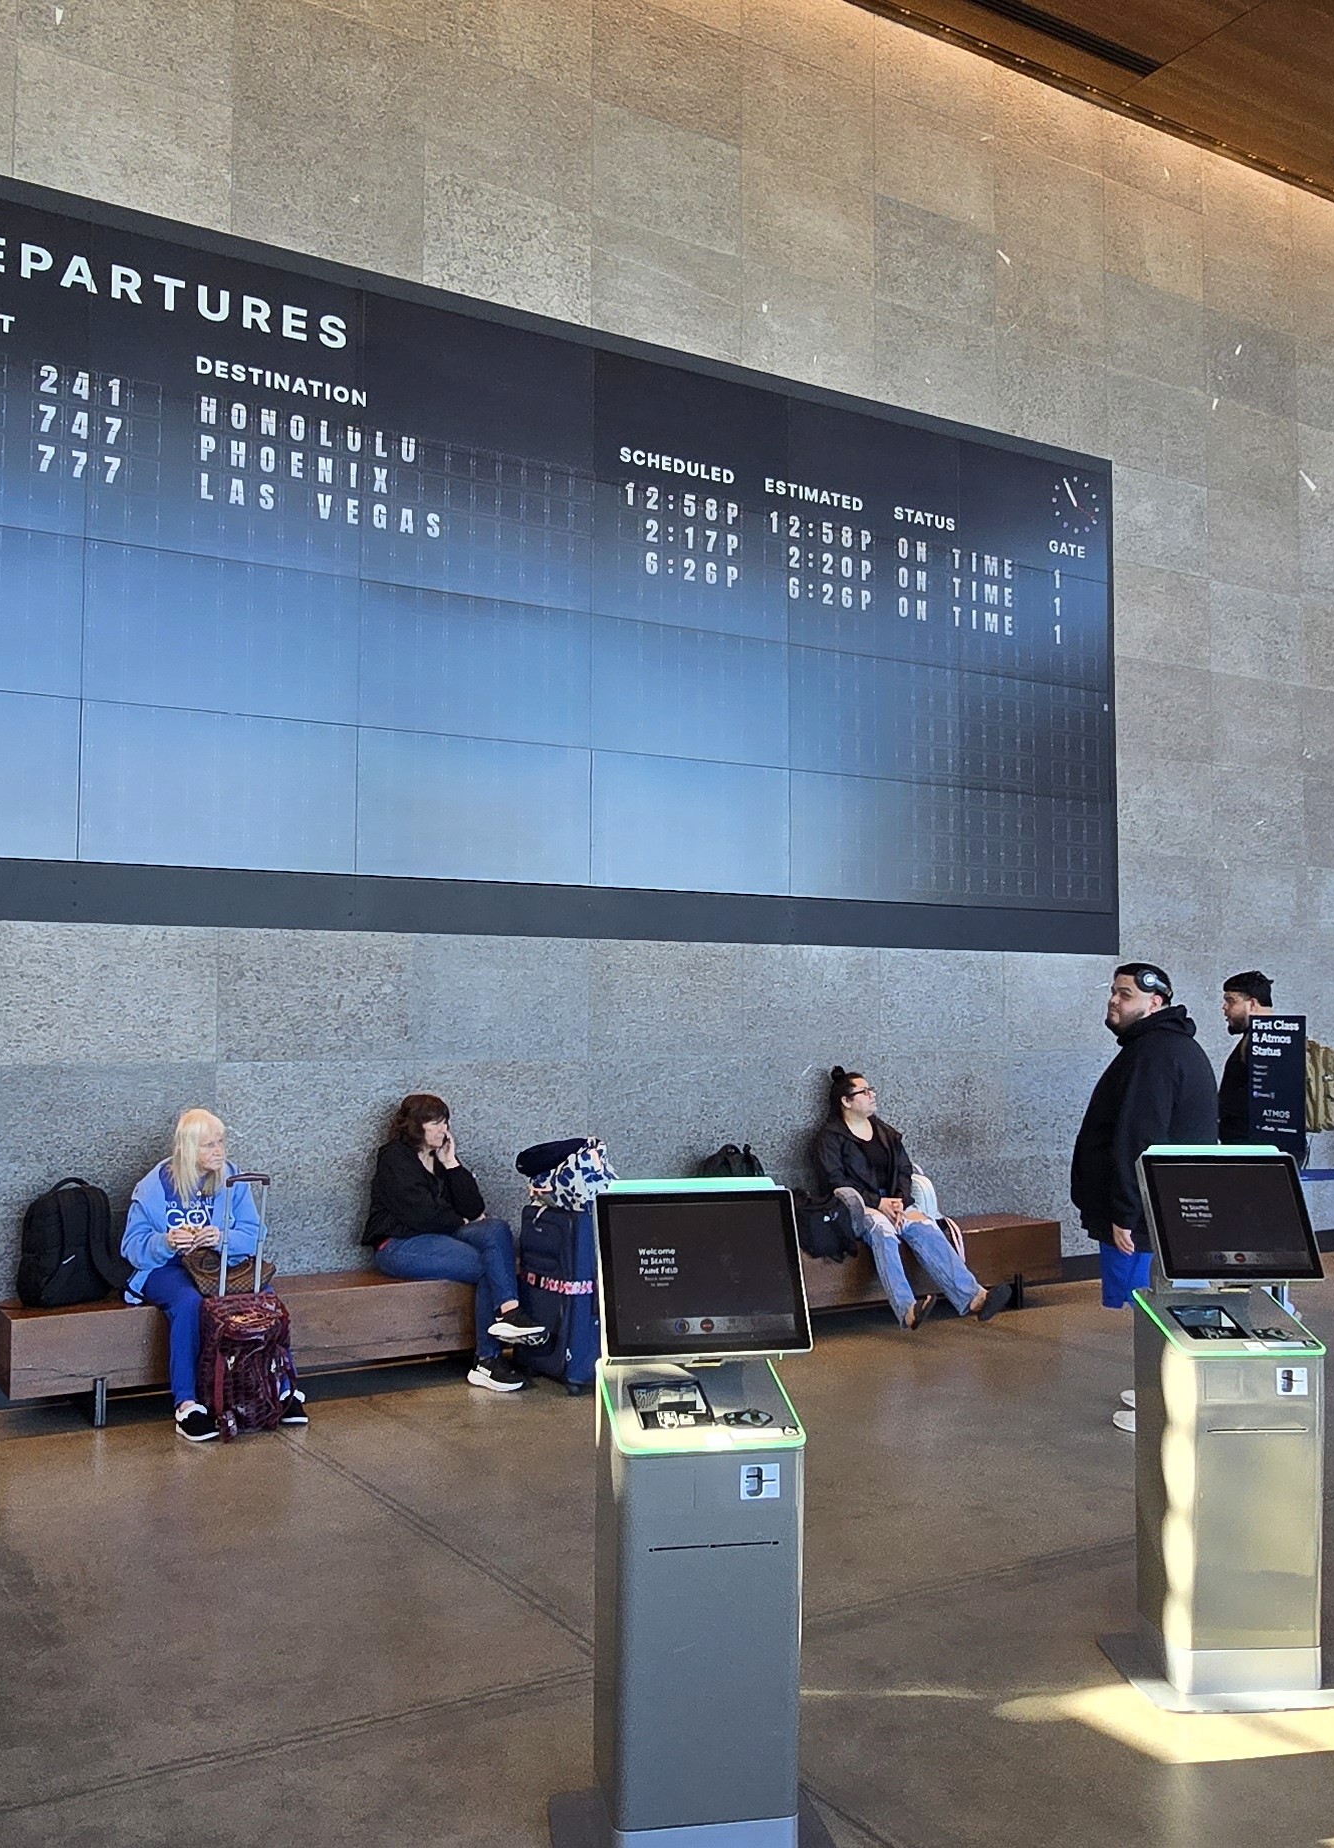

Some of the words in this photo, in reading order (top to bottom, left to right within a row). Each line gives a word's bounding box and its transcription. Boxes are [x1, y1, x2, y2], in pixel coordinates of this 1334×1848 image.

[38, 404, 122, 444] 747
[200, 434, 388, 493] PHOENIX
[645, 519, 739, 556] 2:17P
[788, 546, 872, 581] 2:20P
[898, 567, 927, 592] ON
[952, 577, 1013, 608] TIME
[1054, 597, 1061, 616] 1
[39, 365, 121, 406] 241
[200, 396, 416, 462] HONOLULU
[625, 482, 739, 525] 12:58P
[770, 511, 872, 551] 12:58P
[898, 537, 927, 563] ON
[952, 548, 1013, 580] TIME
[1054, 568, 1061, 589] 1
[196, 356, 367, 407] DESTINATION
[619, 446, 735, 484] SCHEDULED
[764, 478, 863, 511] ESTIMATED
[893, 506, 955, 531] STATUS
[1048, 539, 1086, 559] GATE
[38, 444, 121, 484] 777
[200, 473, 275, 510] LAS
[317, 493, 440, 538] VEGAS
[645, 552, 739, 588] 6:26P
[788, 577, 872, 611] 6:26P
[898, 596, 927, 621] ON
[952, 606, 1014, 636] TIME
[1054, 624, 1061, 645] 1
[1252, 1019, 1273, 1030] First
[1273, 1020, 1300, 1031] Class
[1252, 1032, 1259, 1043] &
[1260, 1032, 1292, 1044] Atmos
[1252, 1045, 1282, 1057] Status
[1262, 1109, 1290, 1119] ATMOS
